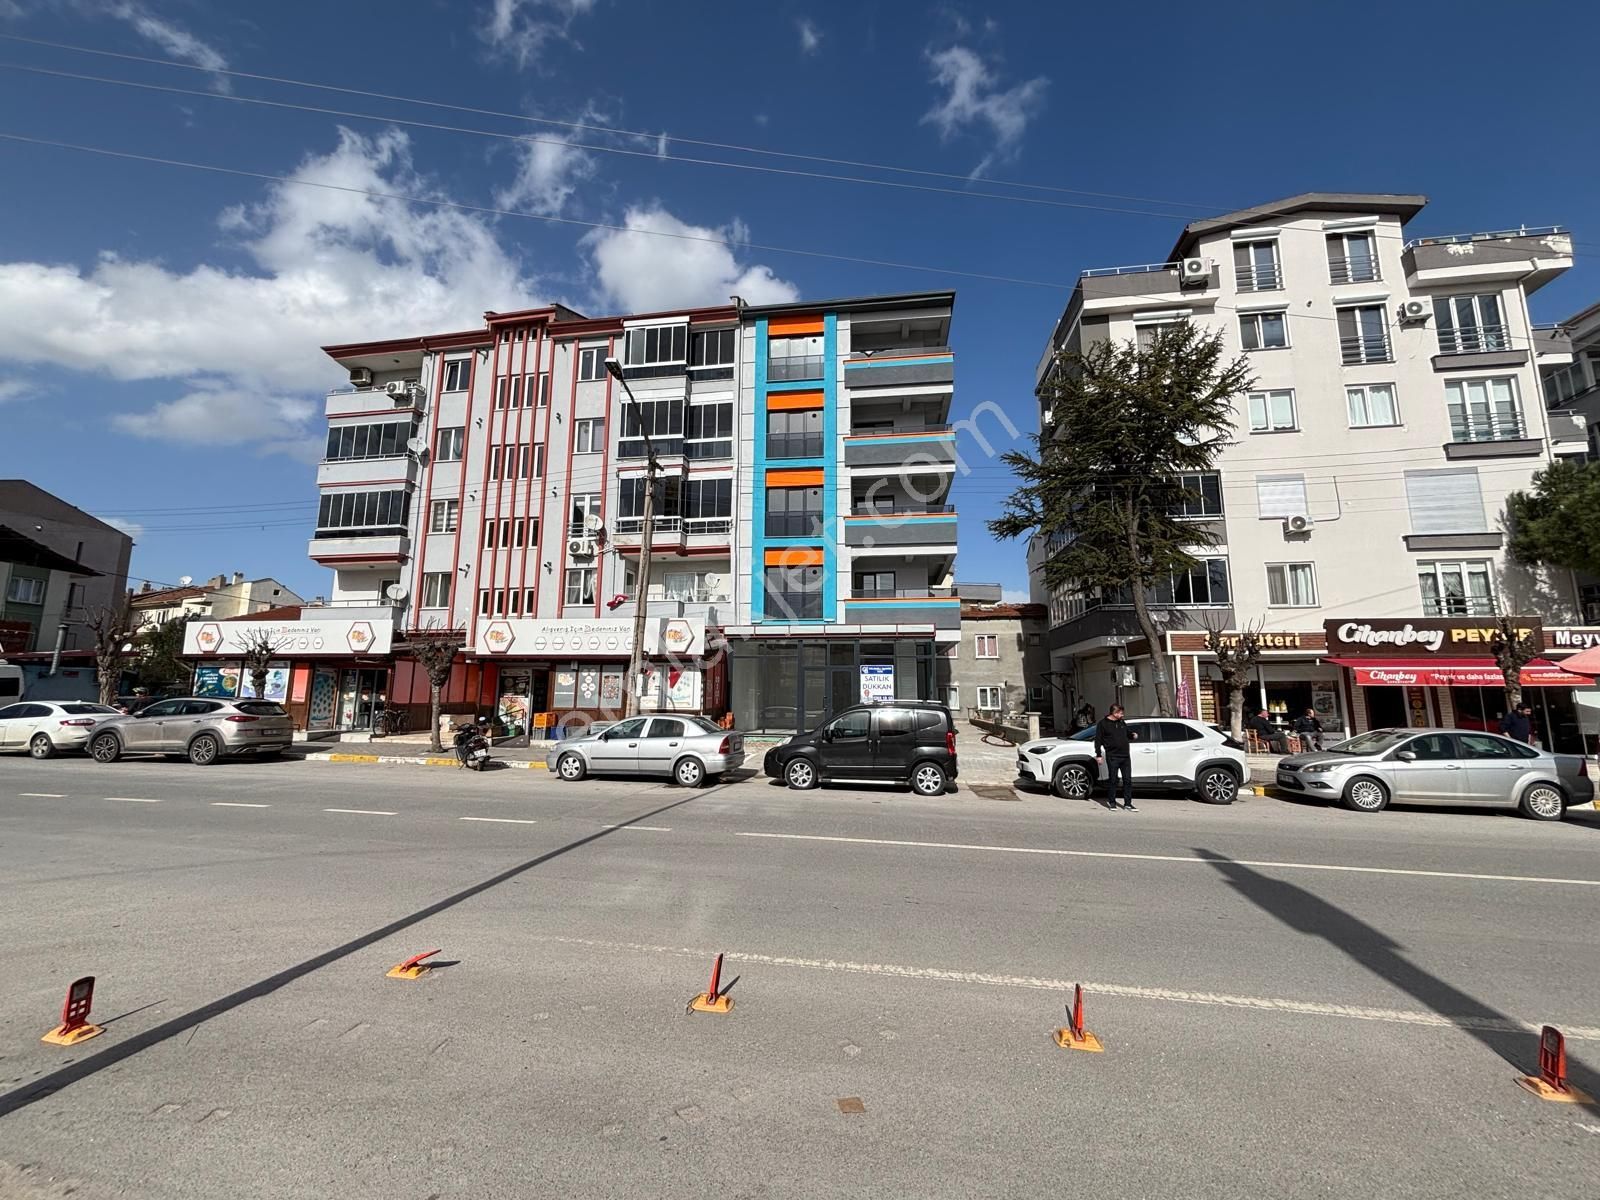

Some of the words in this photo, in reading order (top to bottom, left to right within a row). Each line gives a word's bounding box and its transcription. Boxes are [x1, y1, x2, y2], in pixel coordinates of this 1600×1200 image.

[1204, 632, 1301, 649] Şarüteri
[1338, 622, 1445, 651] Cihanbey
[1451, 628, 1534, 642] PEYR
[1369, 670, 1417, 683] Cihanbey
